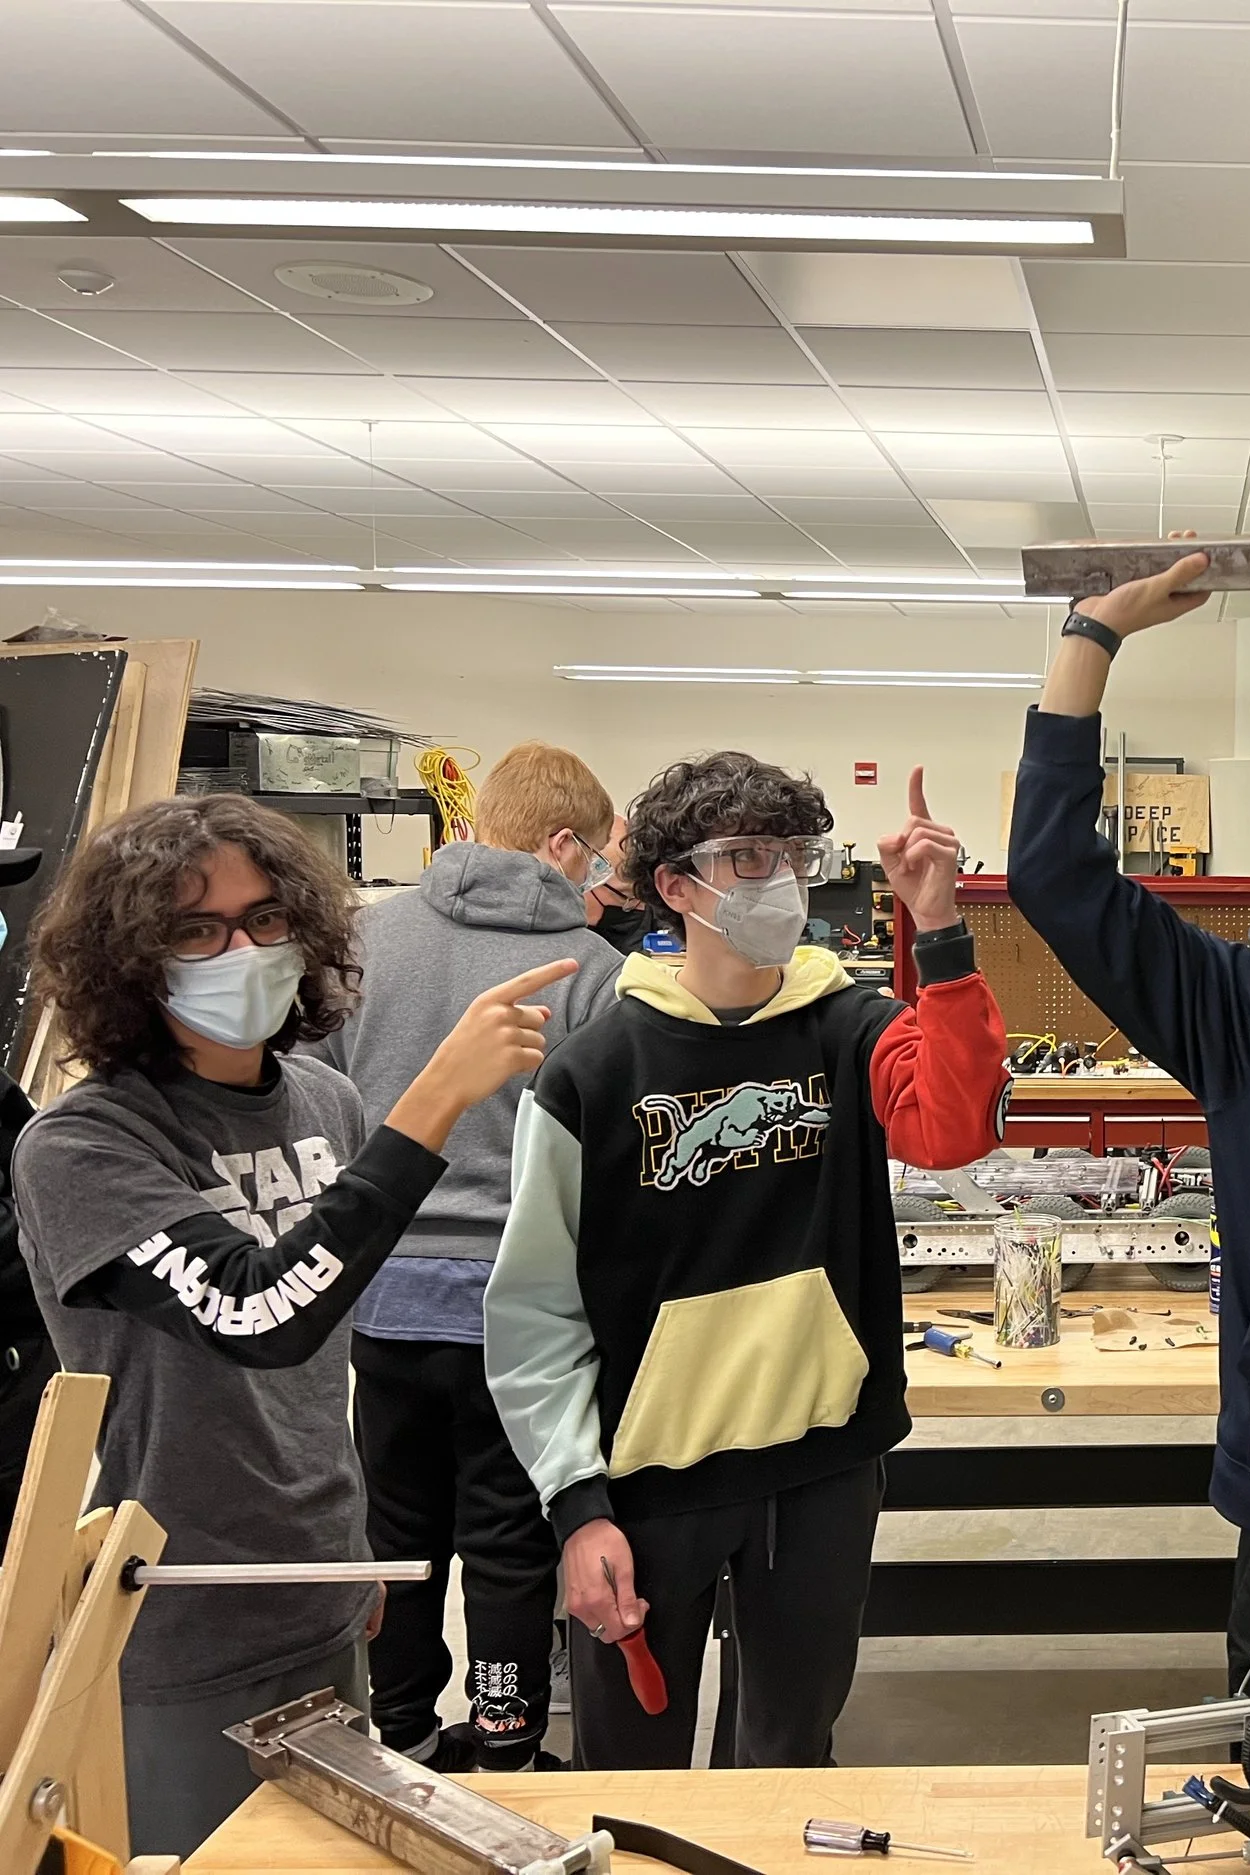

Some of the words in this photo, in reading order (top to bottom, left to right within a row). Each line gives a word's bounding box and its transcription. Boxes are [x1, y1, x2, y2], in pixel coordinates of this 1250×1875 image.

[1124, 806, 1172, 820] DEEP
[1124, 827, 1181, 842] PCE
[152, 1243, 344, 1336] AMERCAN
